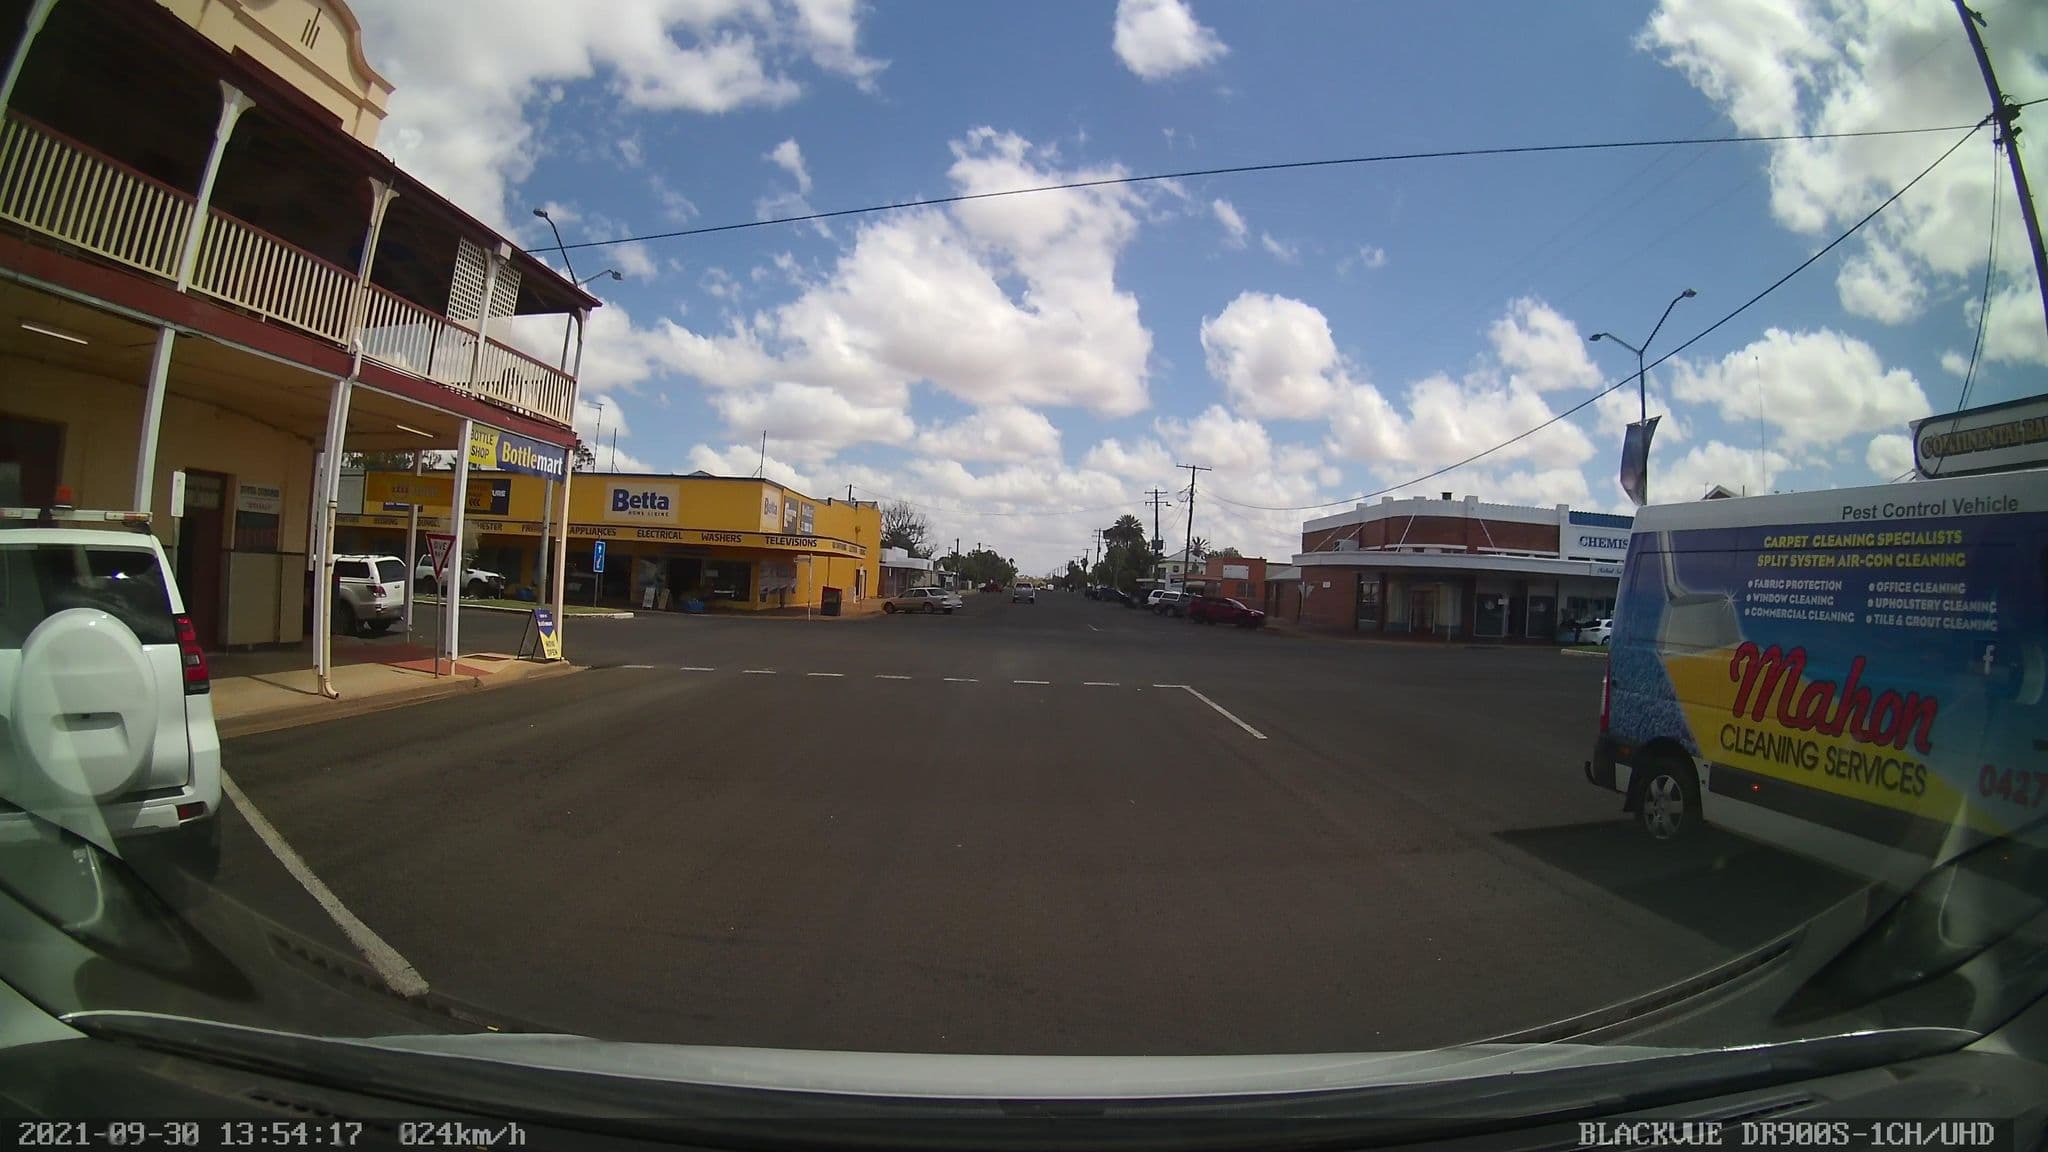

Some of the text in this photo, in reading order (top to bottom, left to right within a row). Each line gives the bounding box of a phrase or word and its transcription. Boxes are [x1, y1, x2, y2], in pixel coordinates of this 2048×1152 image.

[471, 445, 489, 459] SHOP
[502, 441, 563, 475] Bottlemart
[612, 488, 670, 511] Betta
[1842, 494, 2019, 520] Pest Control Vehicle
[569, 526, 617, 537] APPLIANCES
[637, 529, 683, 540] ELECTRICAL
[701, 532, 742, 543] WASHERS
[765, 536, 817, 548] TELEVISIONS
[1763, 530, 1963, 548] CARPET CLEANING SPECIALISTS
[1757, 553, 1966, 568] SPLIT SYSTEM AIR-CON CLEANING
[1754, 579, 1842, 591] FABRIC PROTECTION
[1876, 582, 1966, 595] OFFICE CLEANING
[1752, 593, 1834, 606] WINDOW CLEANING
[1875, 598, 1997, 613] UPHOLSTERY CLEANING
[1751, 607, 1855, 623] COMMERCIAL CLEANING
[1874, 614, 1998, 631] TILE & GROUT CLEANING
[1730, 641, 1938, 755] Mahon
[1720, 723, 1927, 797] CLEANING SERVICES
[1979, 764, 2048, 809] 0427
